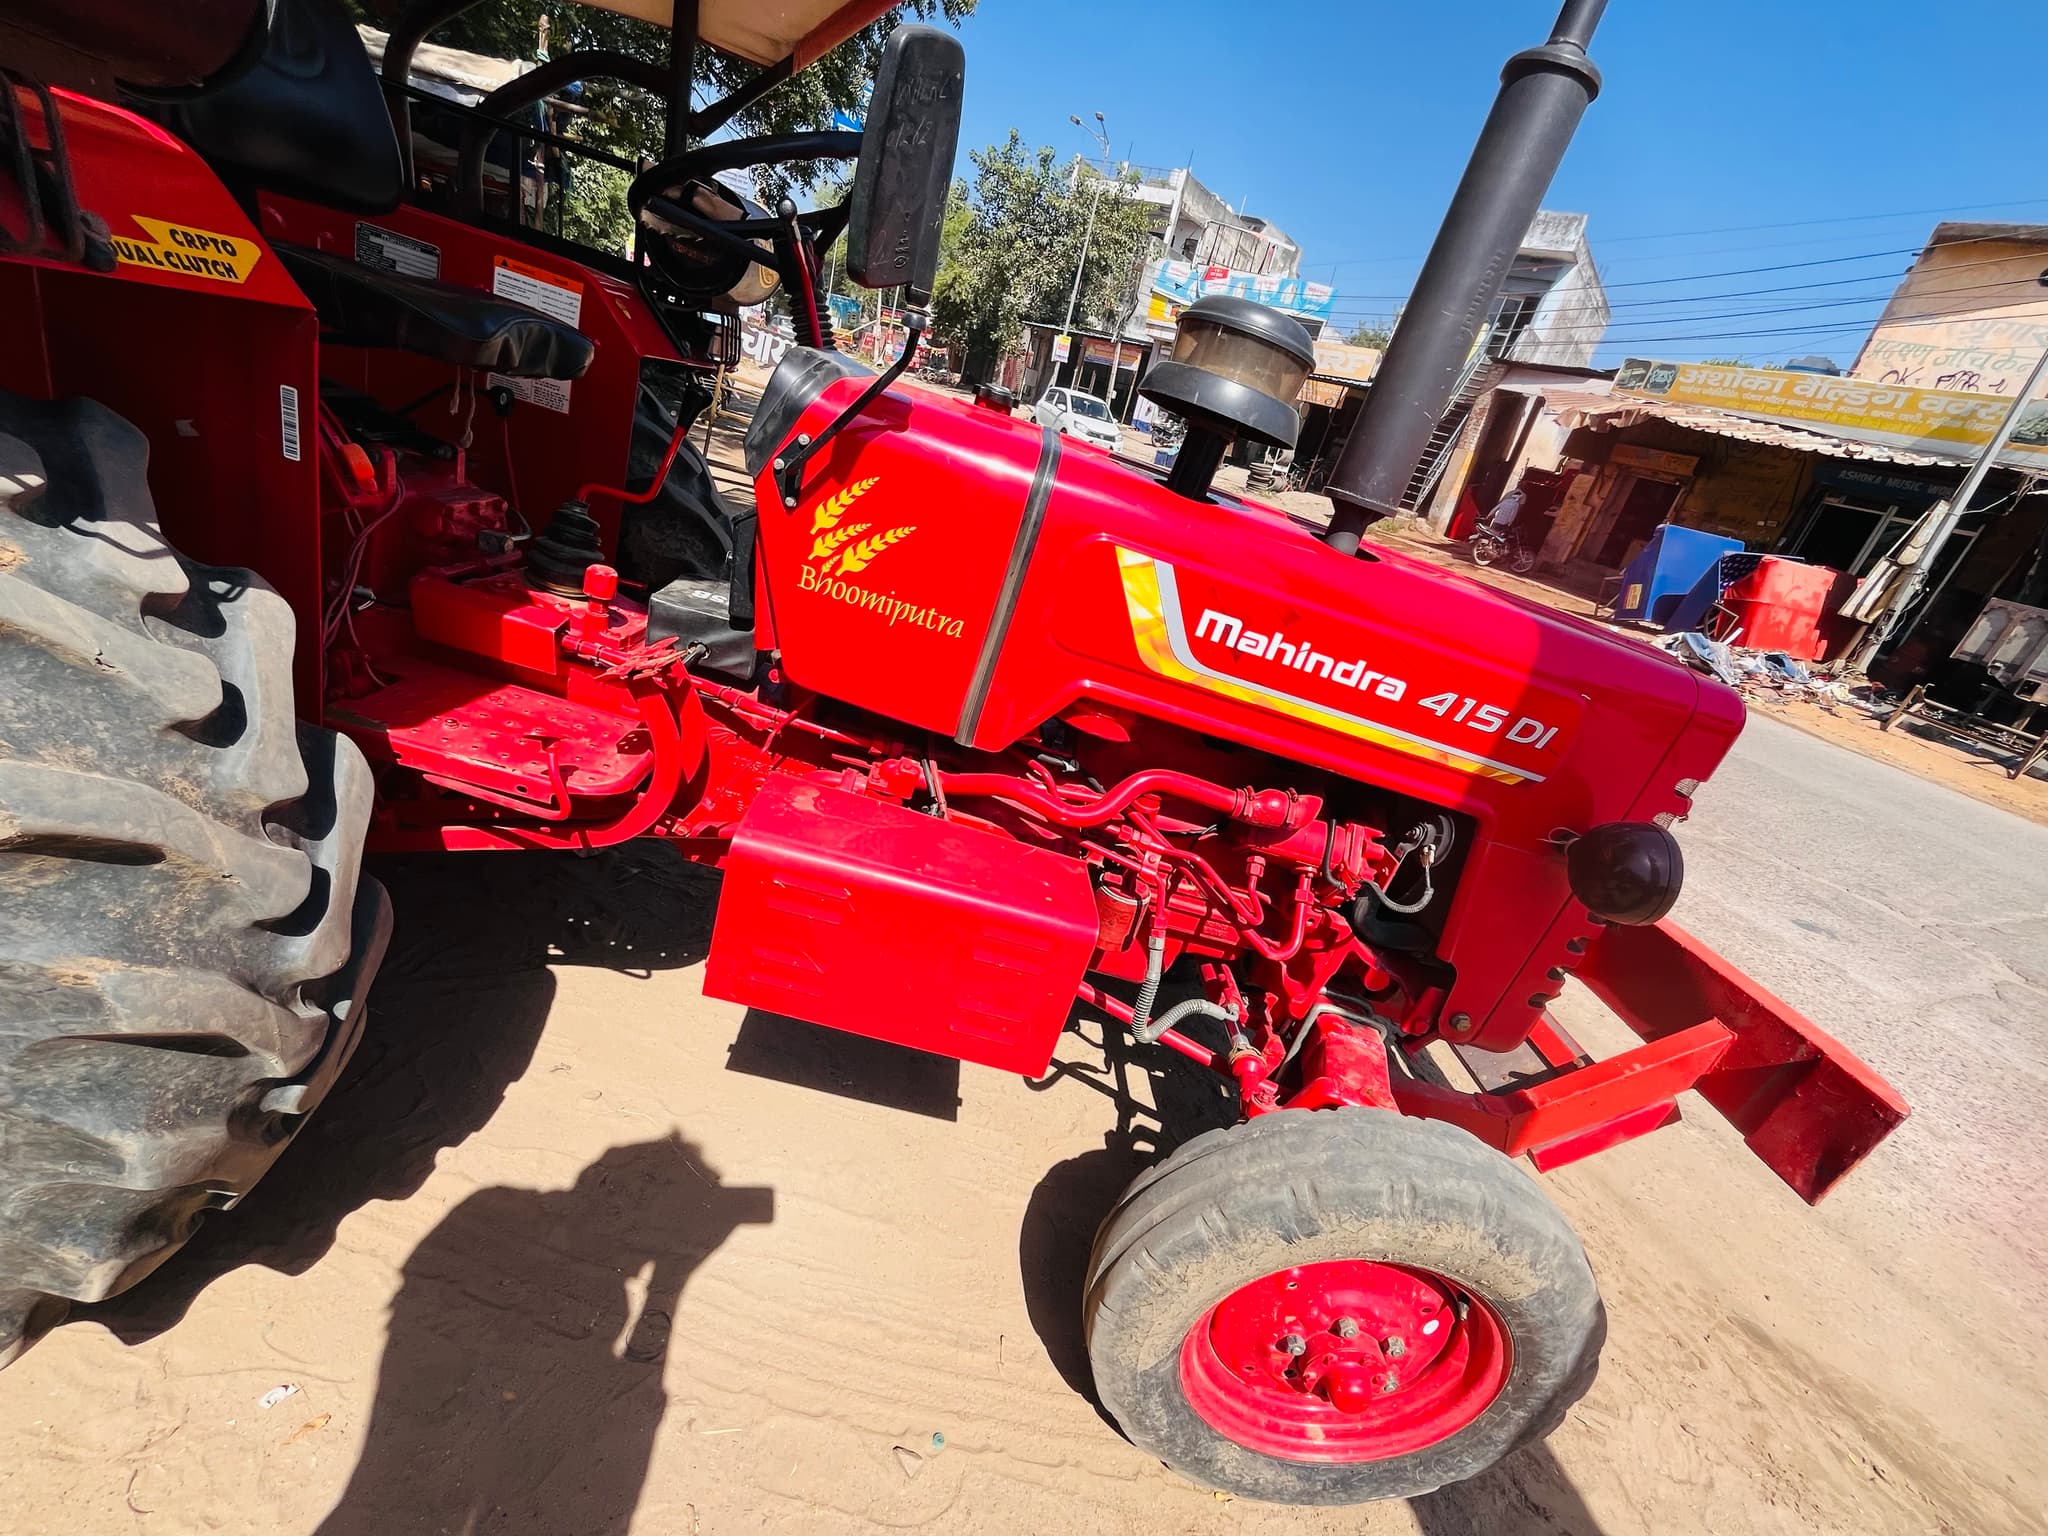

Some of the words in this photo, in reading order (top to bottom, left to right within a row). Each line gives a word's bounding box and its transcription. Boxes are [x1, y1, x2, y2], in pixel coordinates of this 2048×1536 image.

[169, 228, 238, 257] CRPTO
[163, 251, 239, 280] CLUTCH
[797, 563, 965, 638] Bhoomiputra
[1417, 692, 1510, 733] 415
[1505, 717, 1559, 750] DI
